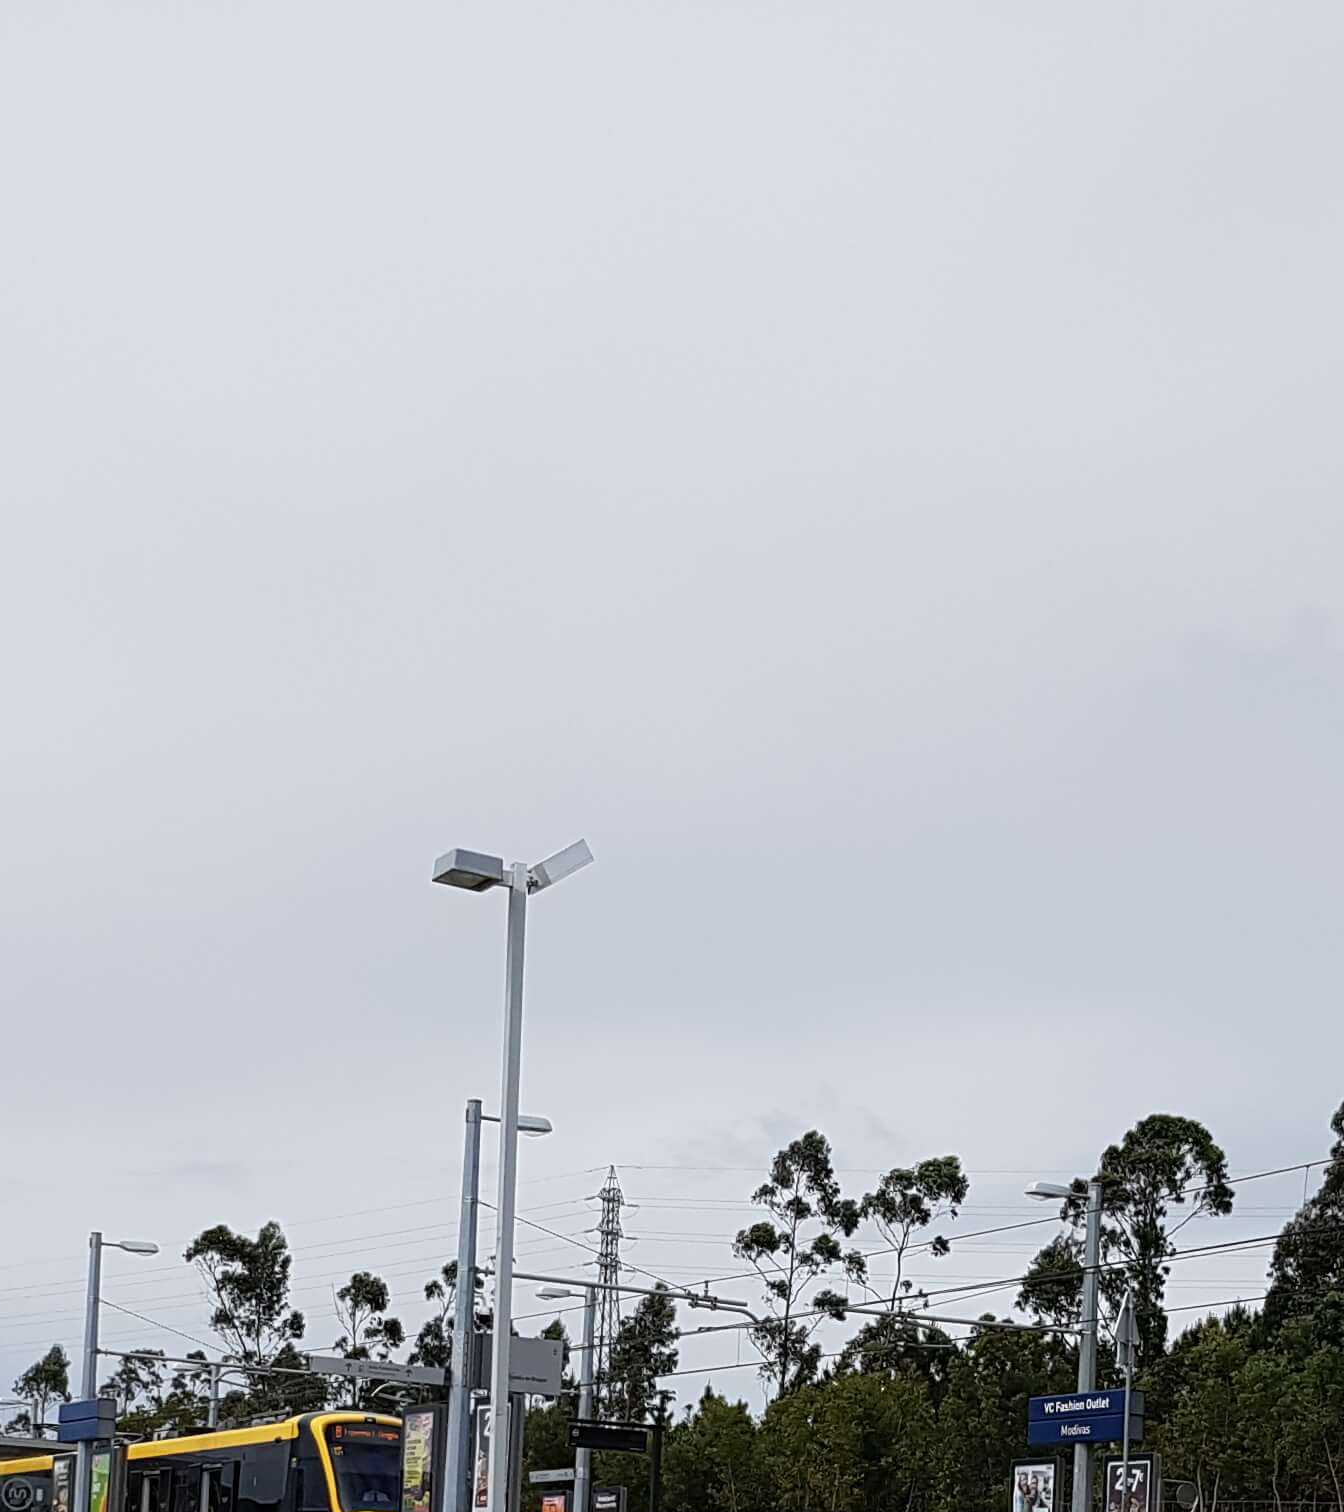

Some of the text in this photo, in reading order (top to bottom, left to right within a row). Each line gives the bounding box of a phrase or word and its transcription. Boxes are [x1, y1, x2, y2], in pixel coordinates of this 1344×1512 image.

[1044, 1397, 1110, 1414] VC Fashion Outlet
[1060, 1423, 1091, 1437] Modivas
